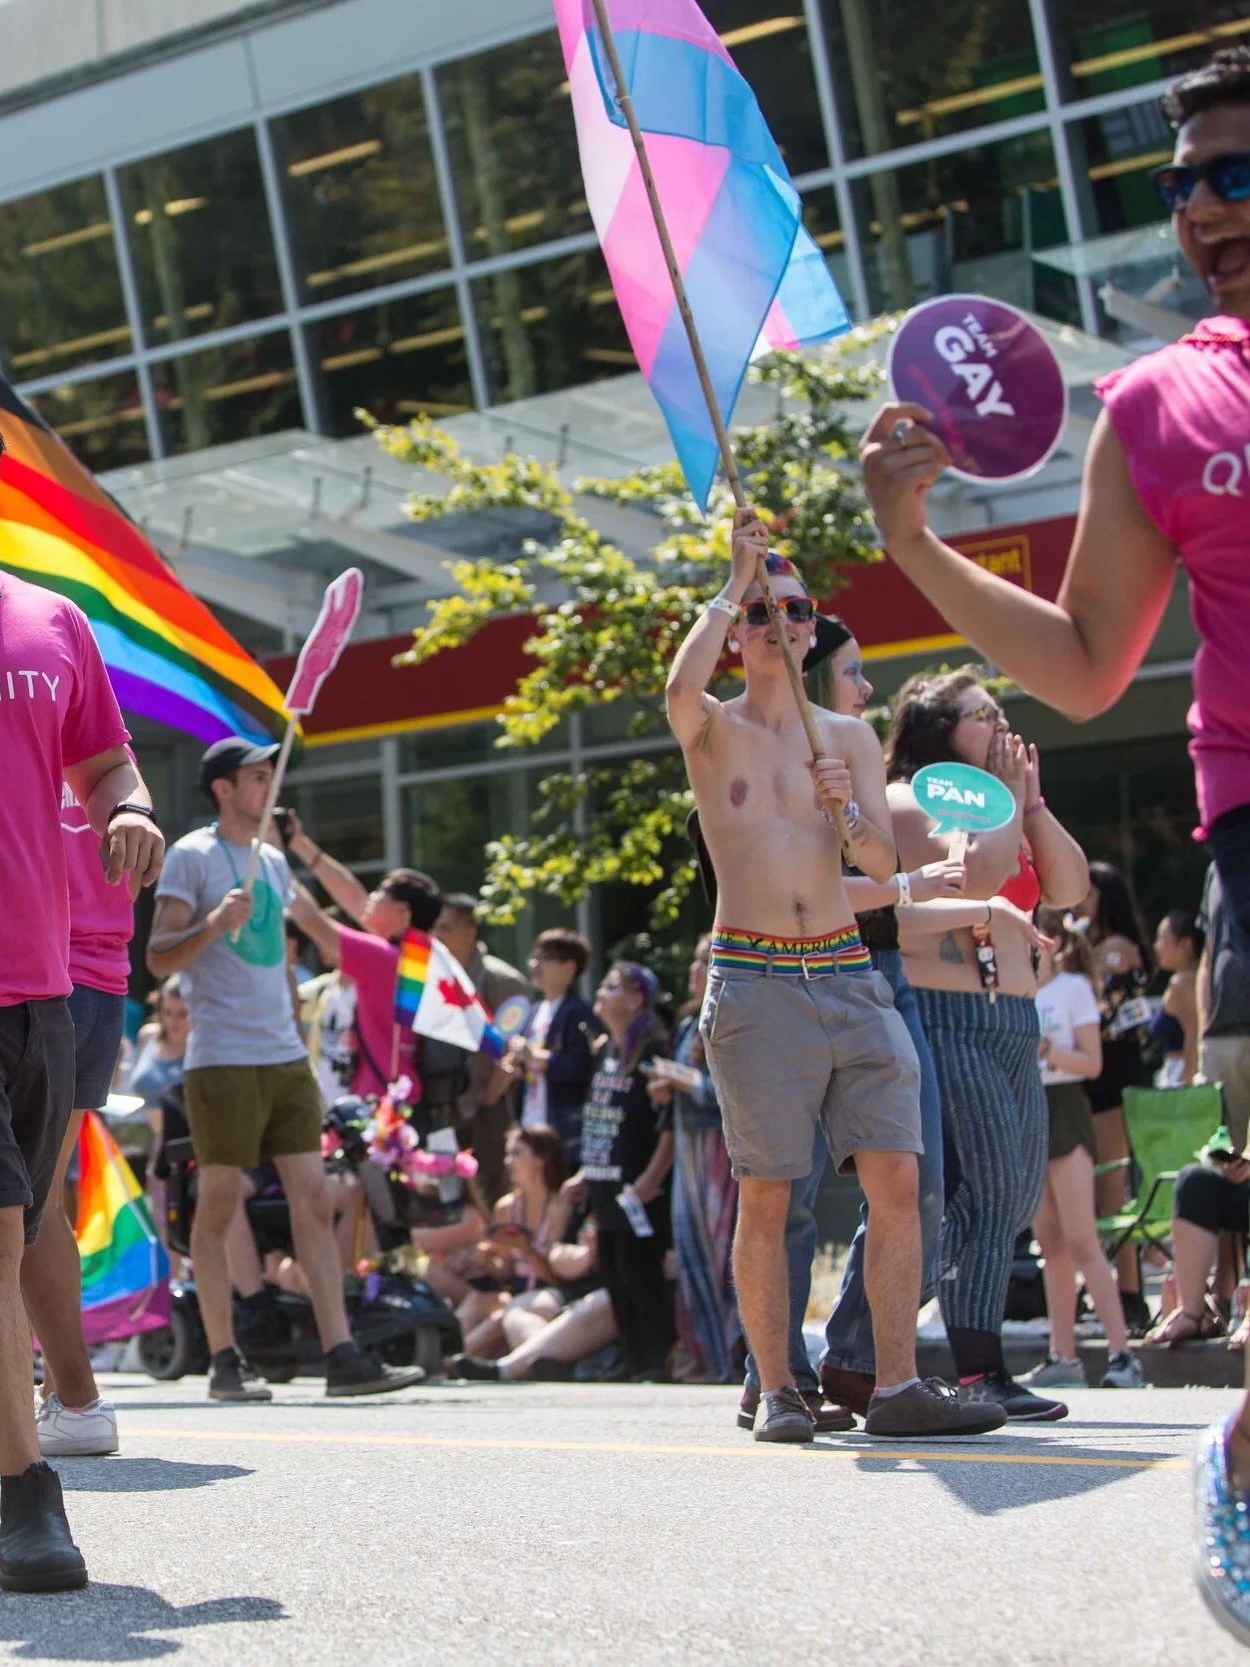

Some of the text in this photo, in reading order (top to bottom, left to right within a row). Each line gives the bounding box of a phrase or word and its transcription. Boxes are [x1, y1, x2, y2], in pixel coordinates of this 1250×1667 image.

[962, 312, 998, 358] TEAM
[934, 326, 1016, 417] GAY
[926, 776, 954, 787] TEAM
[926, 783, 985, 808] PAN
[766, 929, 859, 955] AMERICAN
